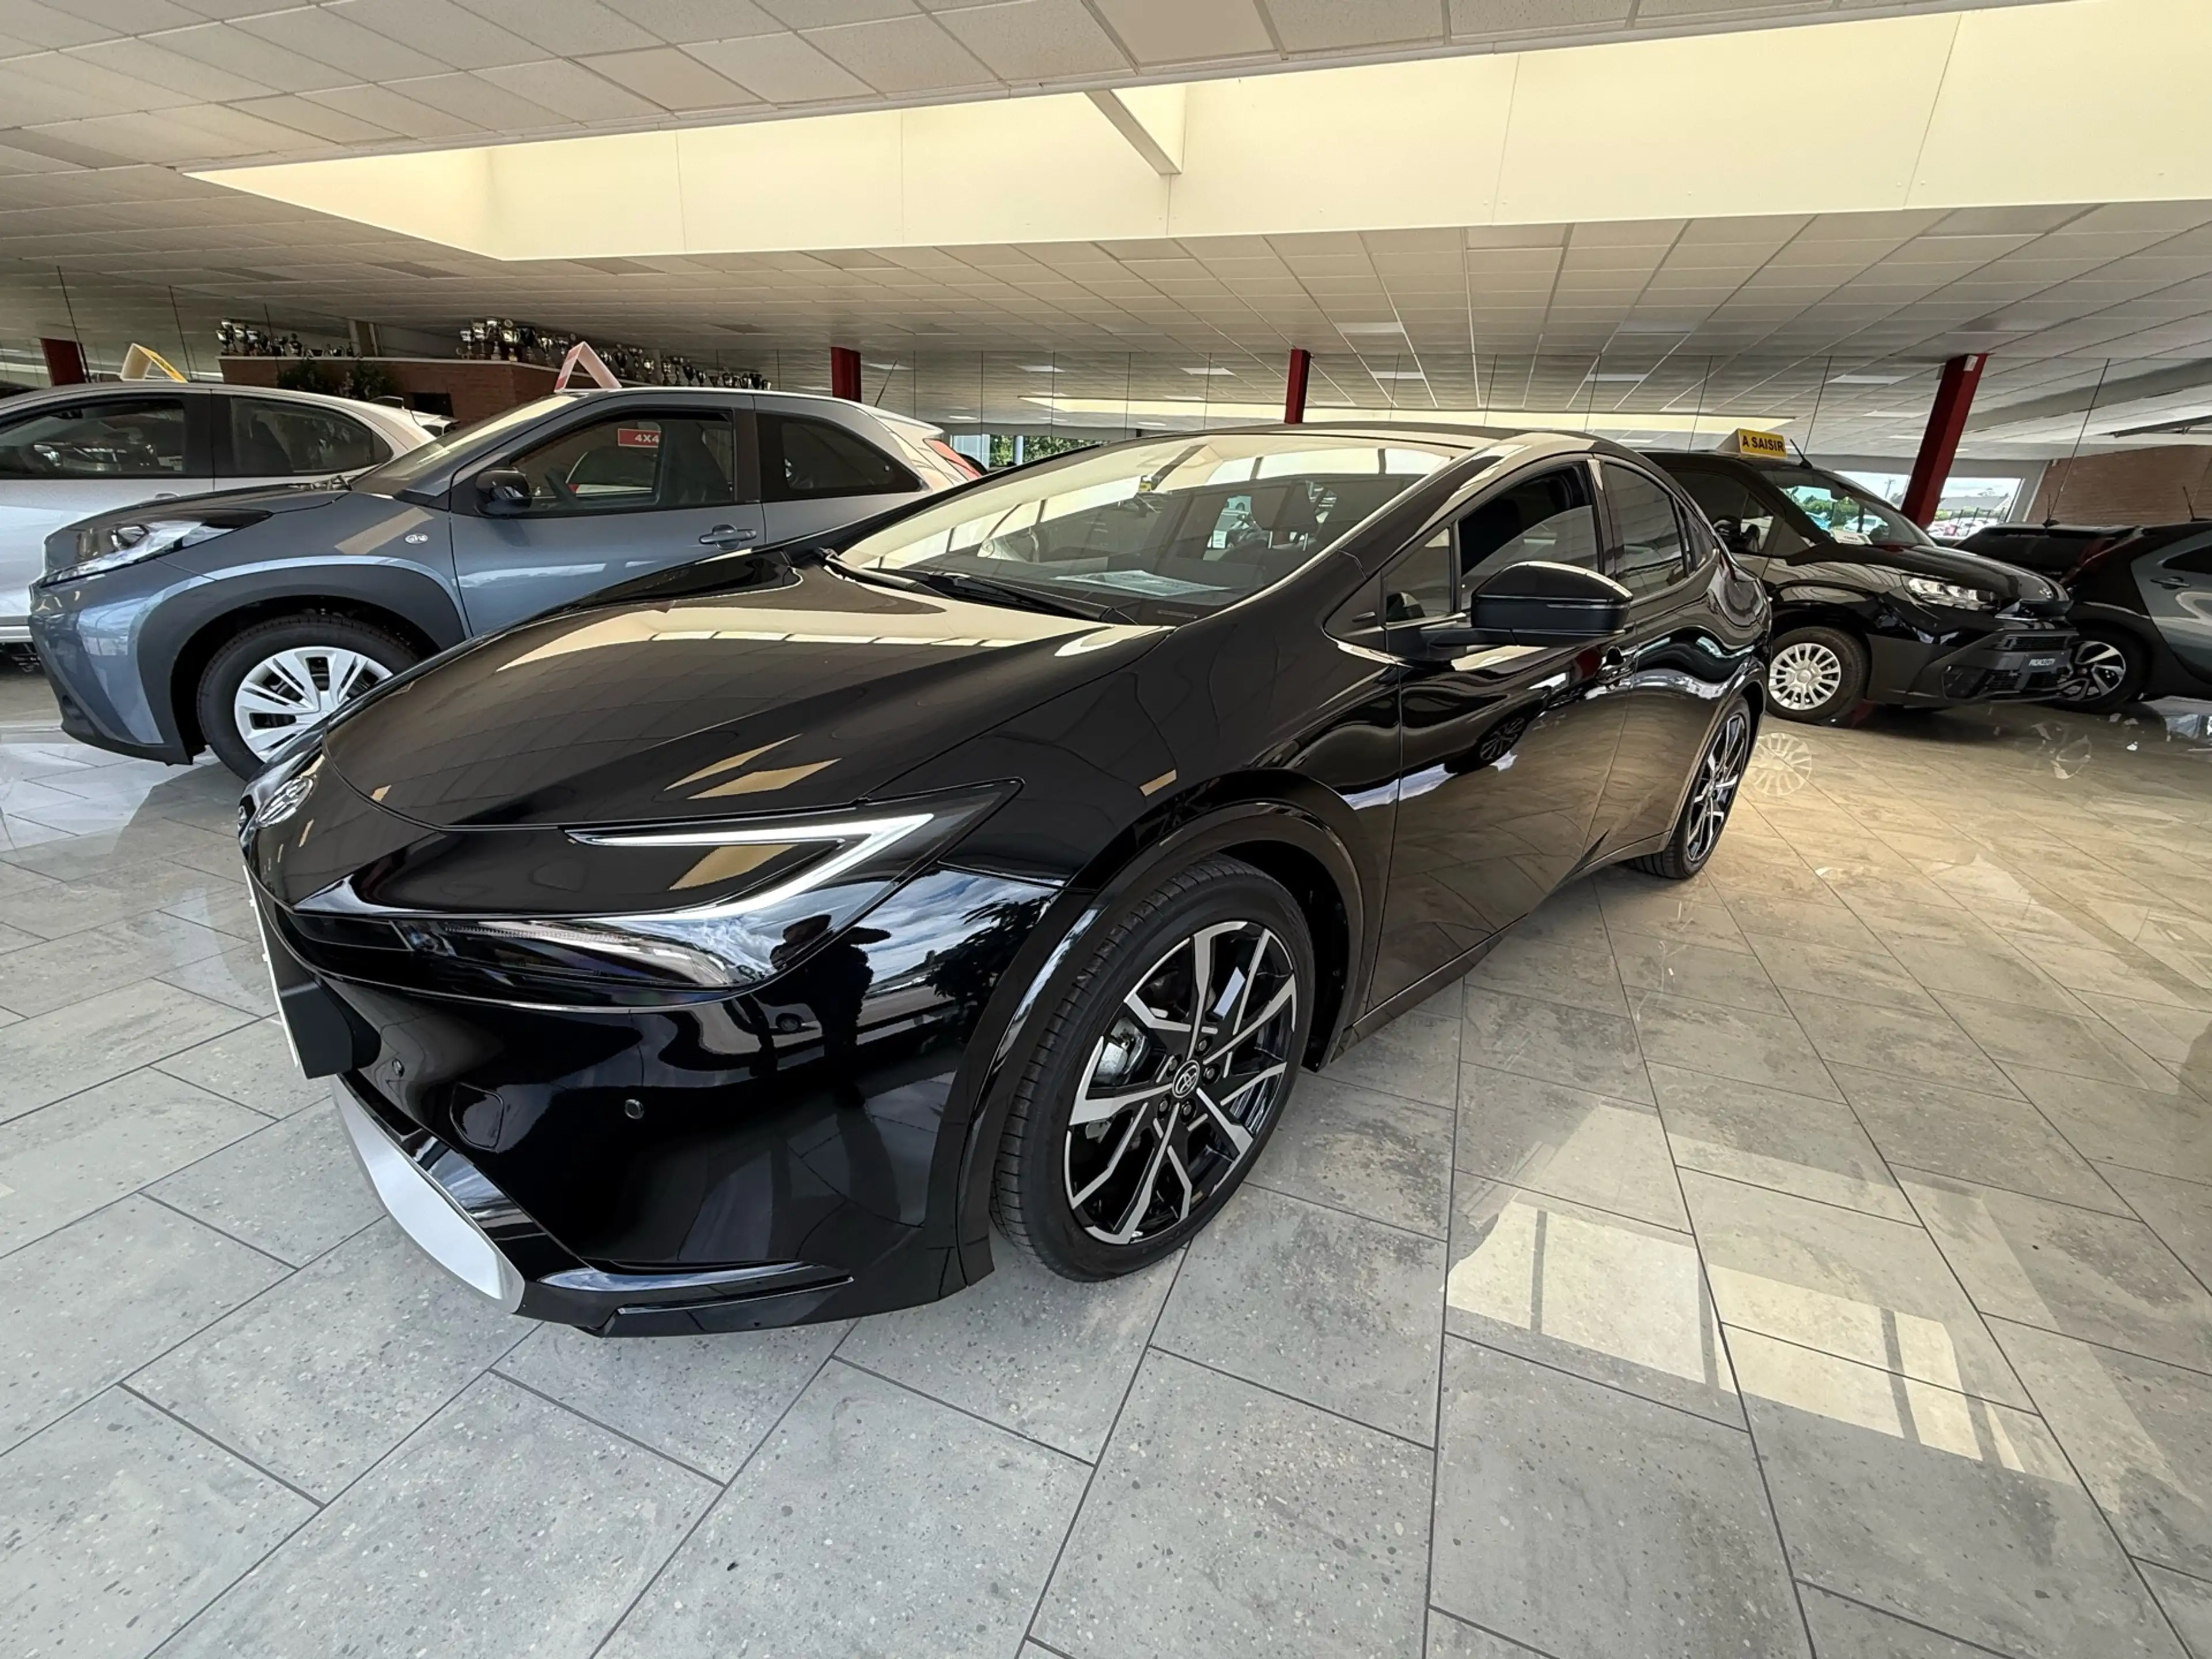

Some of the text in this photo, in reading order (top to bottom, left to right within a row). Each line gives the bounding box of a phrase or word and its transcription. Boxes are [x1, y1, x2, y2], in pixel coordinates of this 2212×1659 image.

[634, 434, 660, 443] 4X4
[1743, 435, 1785, 452] A SAISIR
